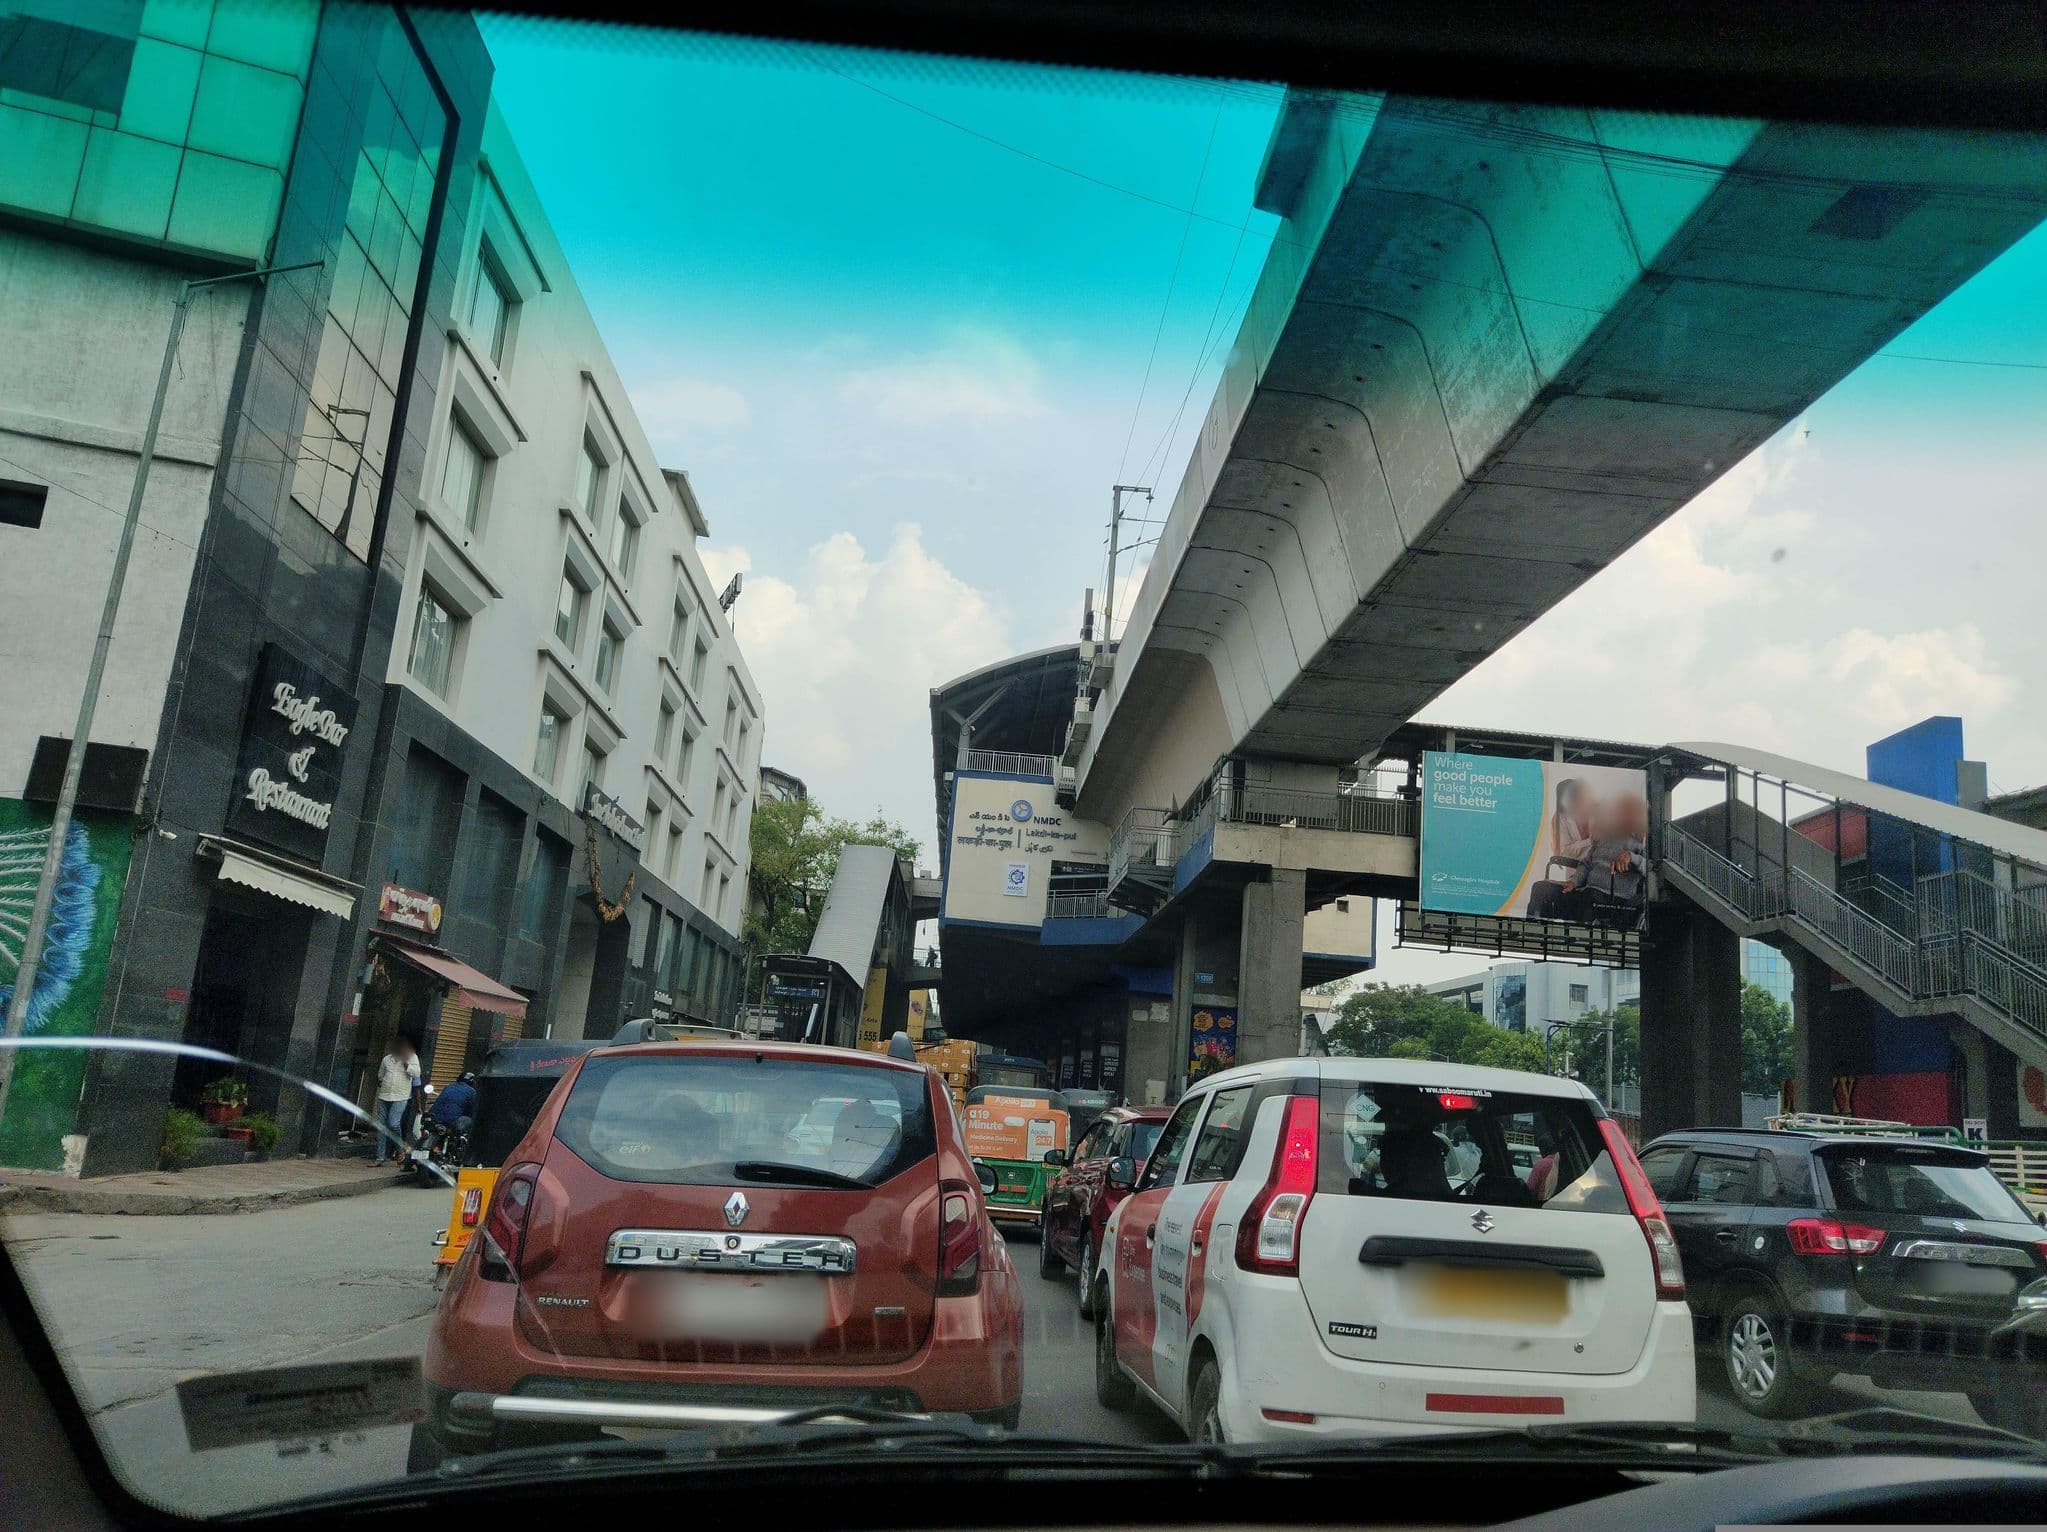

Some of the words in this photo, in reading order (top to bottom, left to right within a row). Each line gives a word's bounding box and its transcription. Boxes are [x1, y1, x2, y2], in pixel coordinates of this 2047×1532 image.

[316, 710, 349, 748] Bar
[288, 746, 316, 783] &
[1434, 756, 1473, 770] Where
[1434, 771, 1466, 783] good
[1470, 774, 1513, 787] people
[1433, 782, 1467, 794] make
[1469, 786, 1492, 797] you
[246, 768, 332, 830] Restaurant
[1433, 792, 1456, 804] feel
[1460, 796, 1498, 809] better
[1033, 815, 1062, 826] NMDC
[995, 1096, 1020, 1106] Apollo
[1357, 1103, 1375, 1112] CNG
[977, 1109, 990, 1119] 19
[968, 1119, 1004, 1131] Minute
[1967, 1127, 1984, 1141] K
[617, 1245, 844, 1269] DUSTER
[537, 1296, 589, 1308] RENAULT
[1331, 1325, 1361, 1335] TOUR
